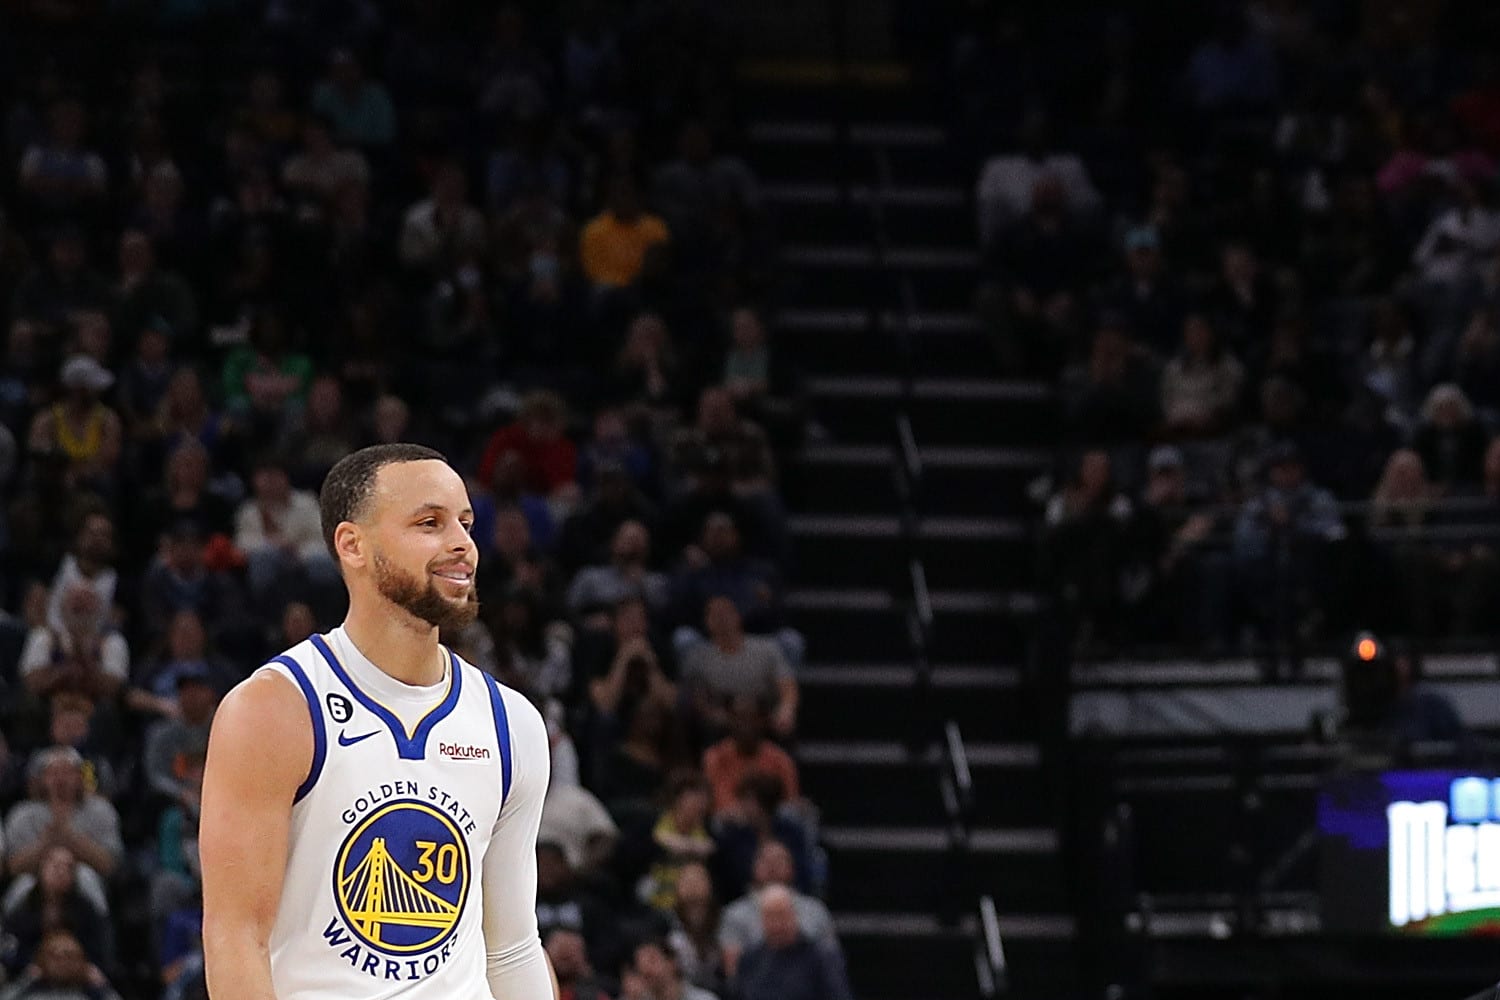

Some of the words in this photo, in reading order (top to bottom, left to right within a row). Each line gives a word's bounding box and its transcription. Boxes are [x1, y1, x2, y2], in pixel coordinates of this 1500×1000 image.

[330, 698, 348, 720] 6
[439, 742, 490, 760] Rakuten
[342, 781, 419, 825] GOLDEN
[428, 786, 476, 834] STATE
[412, 840, 459, 884] 30
